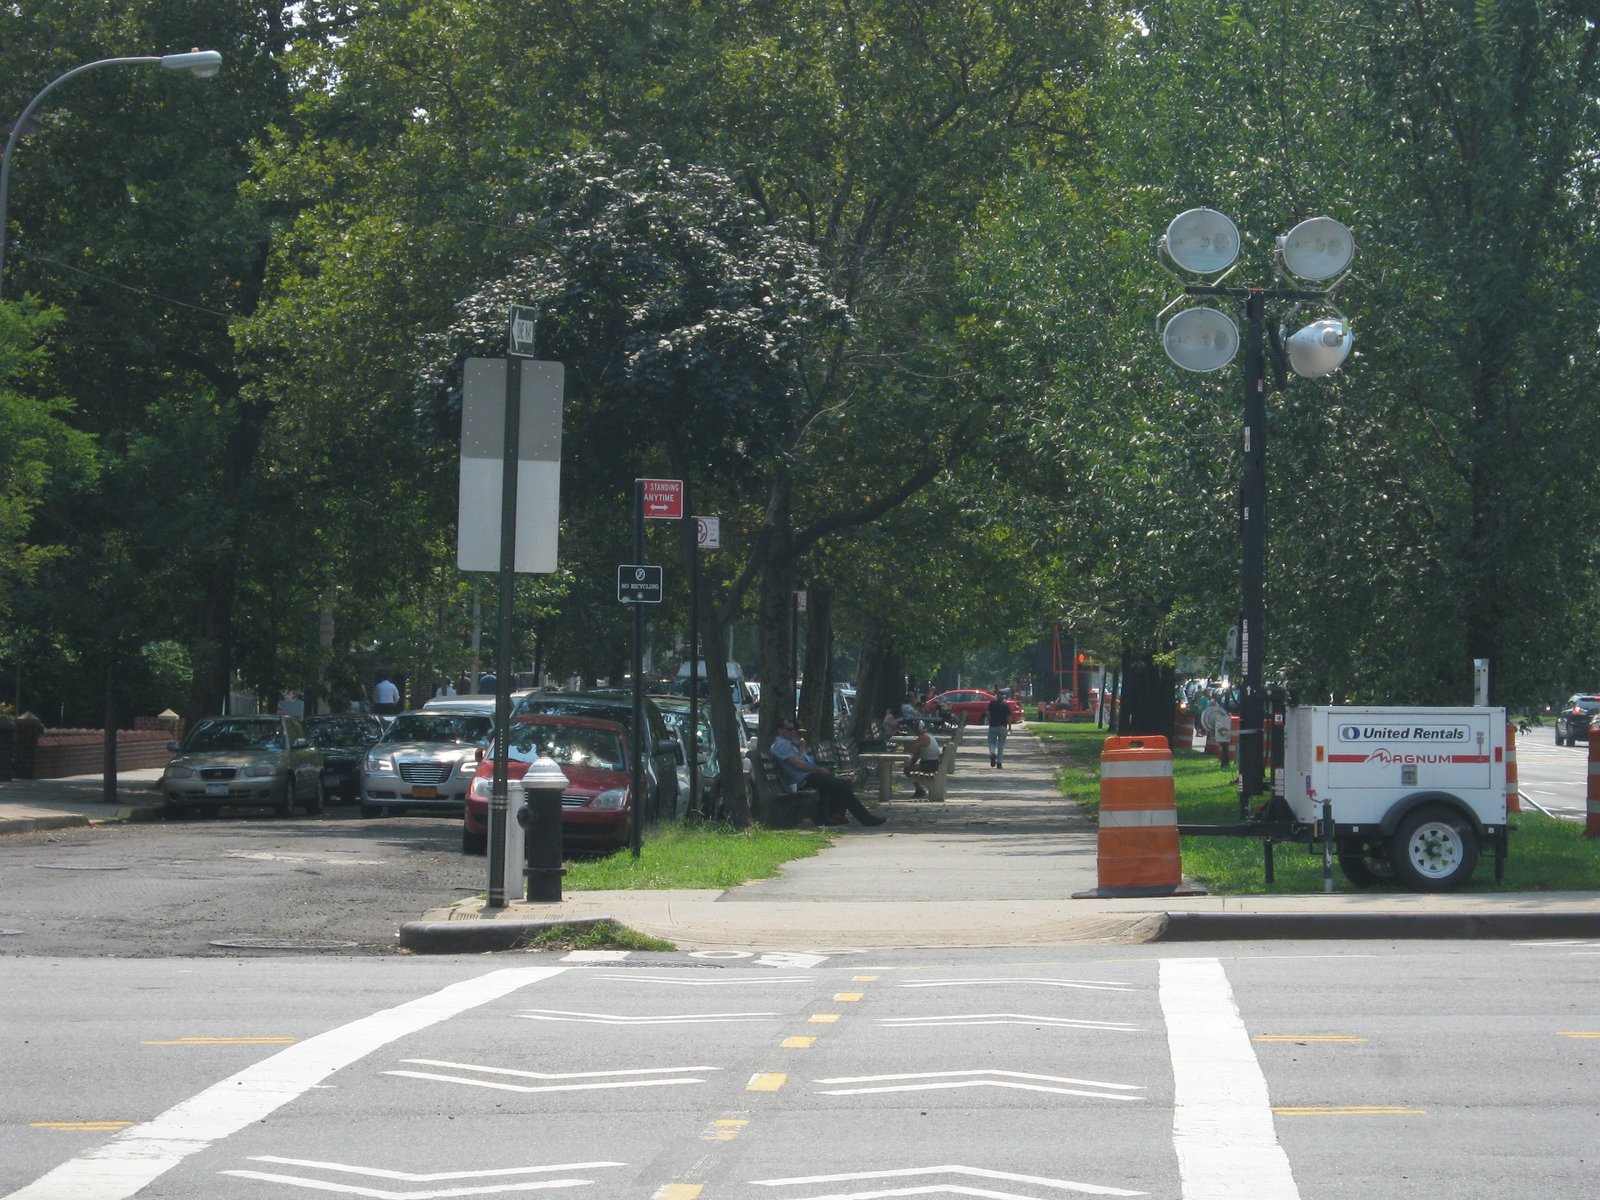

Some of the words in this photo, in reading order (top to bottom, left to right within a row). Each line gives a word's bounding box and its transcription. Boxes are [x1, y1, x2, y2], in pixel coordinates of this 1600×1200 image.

[650, 482, 679, 491] STANDING
[643, 493, 674, 502] ANYTIME
[1363, 727, 1410, 739] United
[1413, 727, 1464, 739] Rentals
[1367, 749, 1451, 766] MAGNUM
